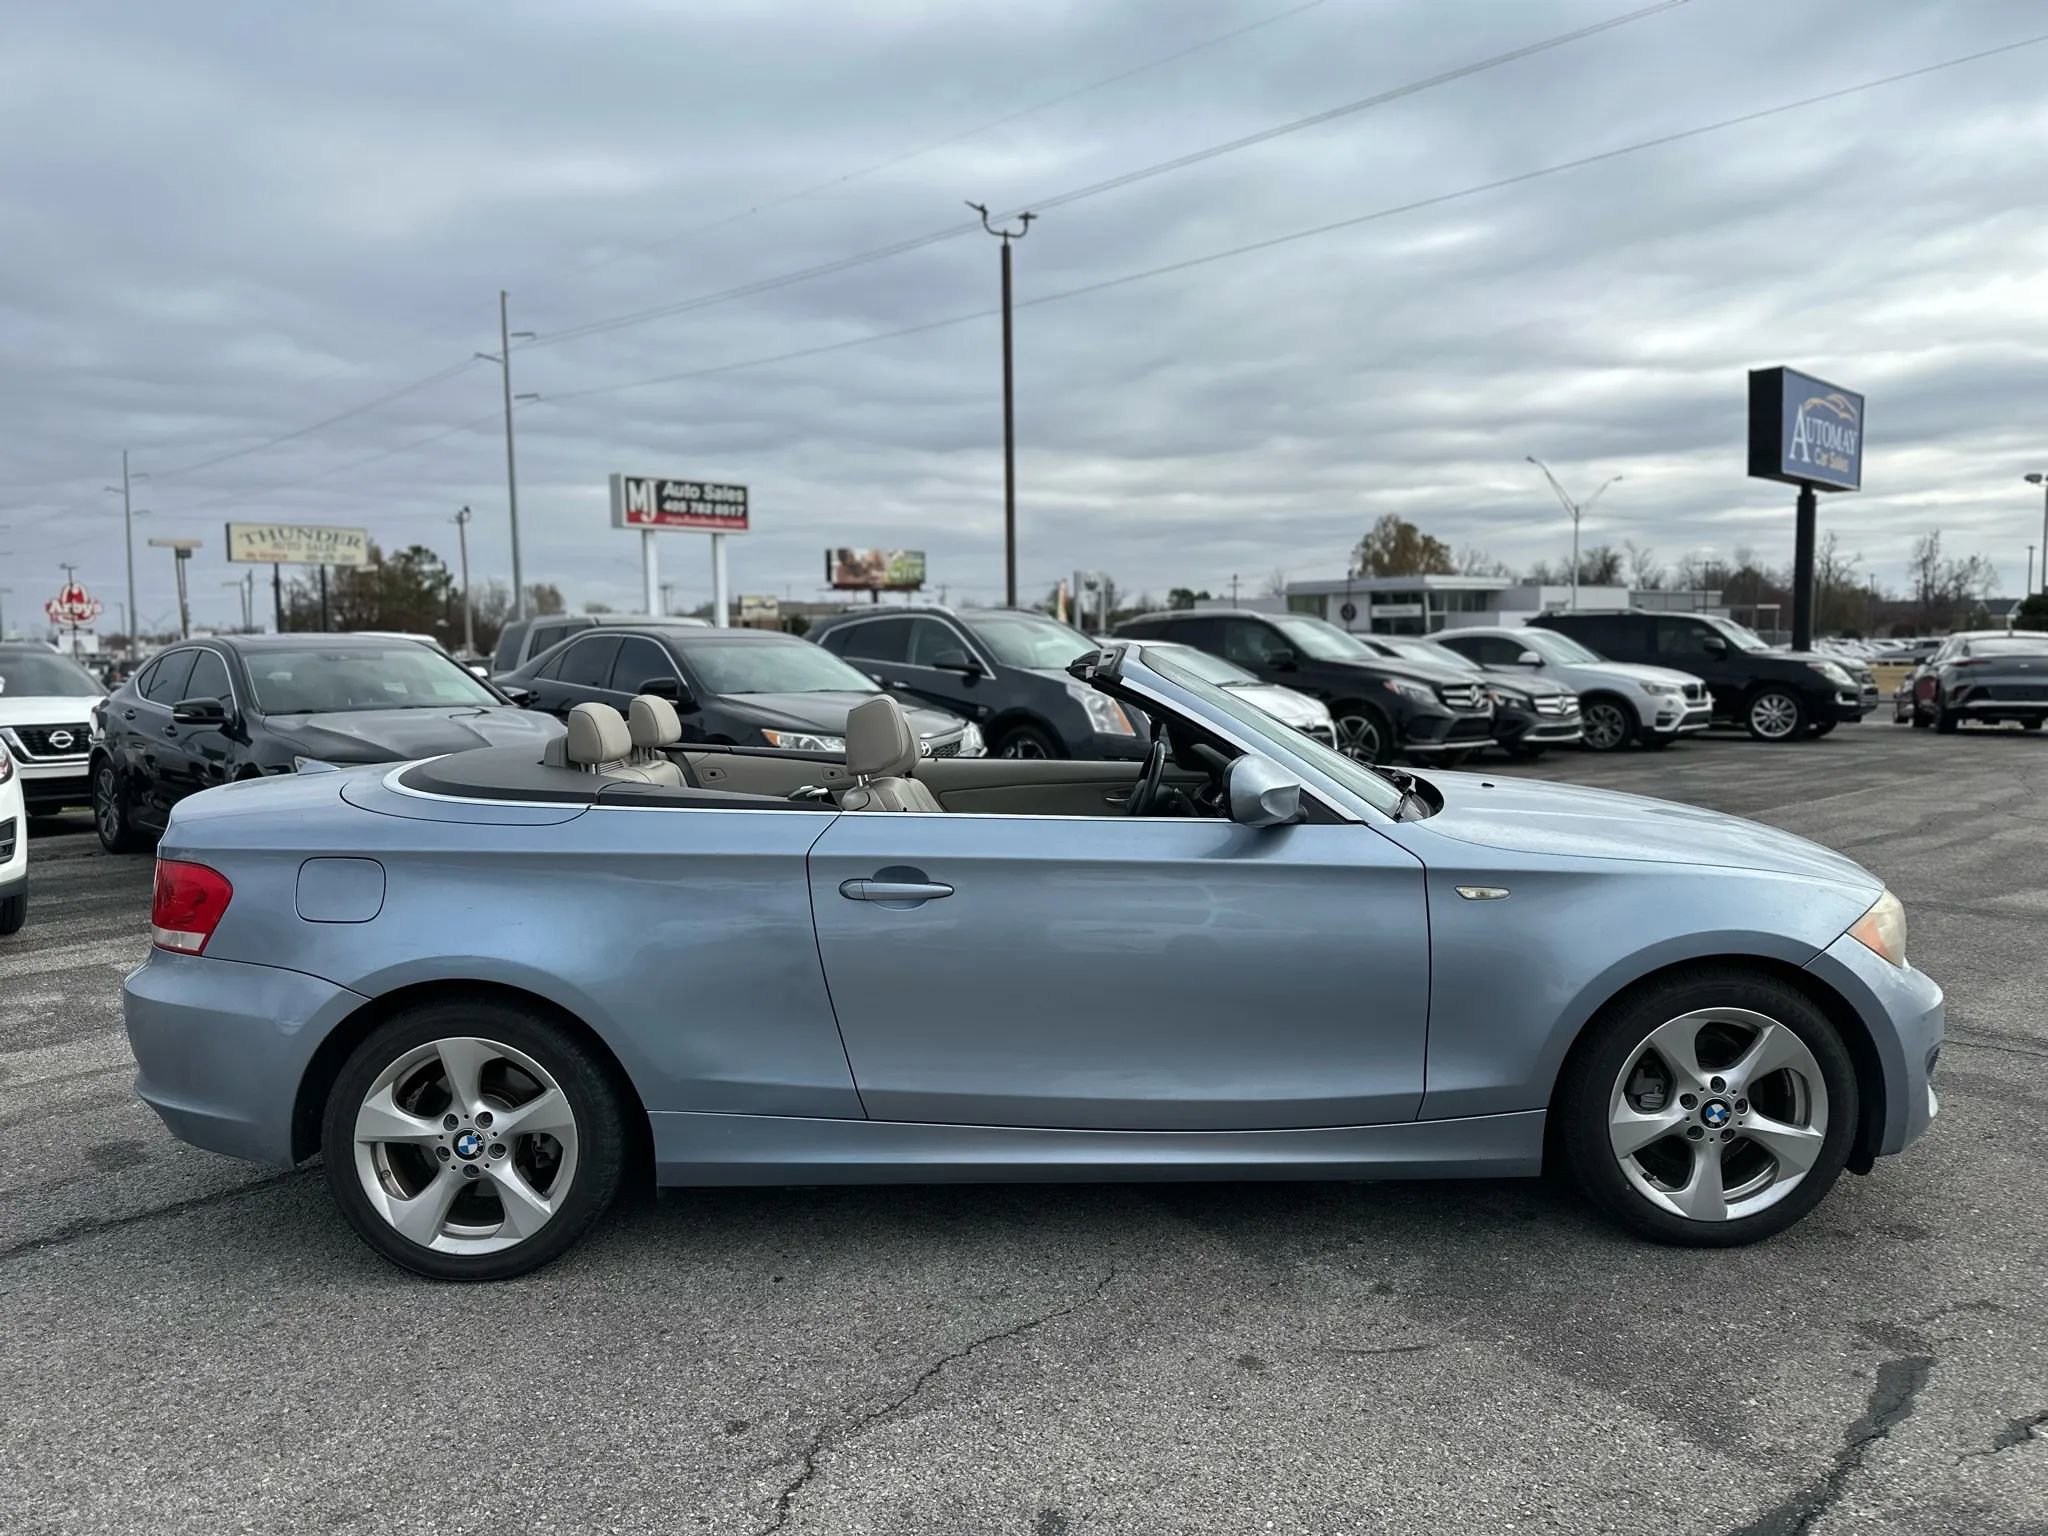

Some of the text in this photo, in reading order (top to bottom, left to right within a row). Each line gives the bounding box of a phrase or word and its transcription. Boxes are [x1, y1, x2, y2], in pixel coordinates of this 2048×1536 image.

[627, 479, 658, 523] MJ
[662, 481, 745, 503] Auto Sales
[238, 527, 362, 550] THUNDER
